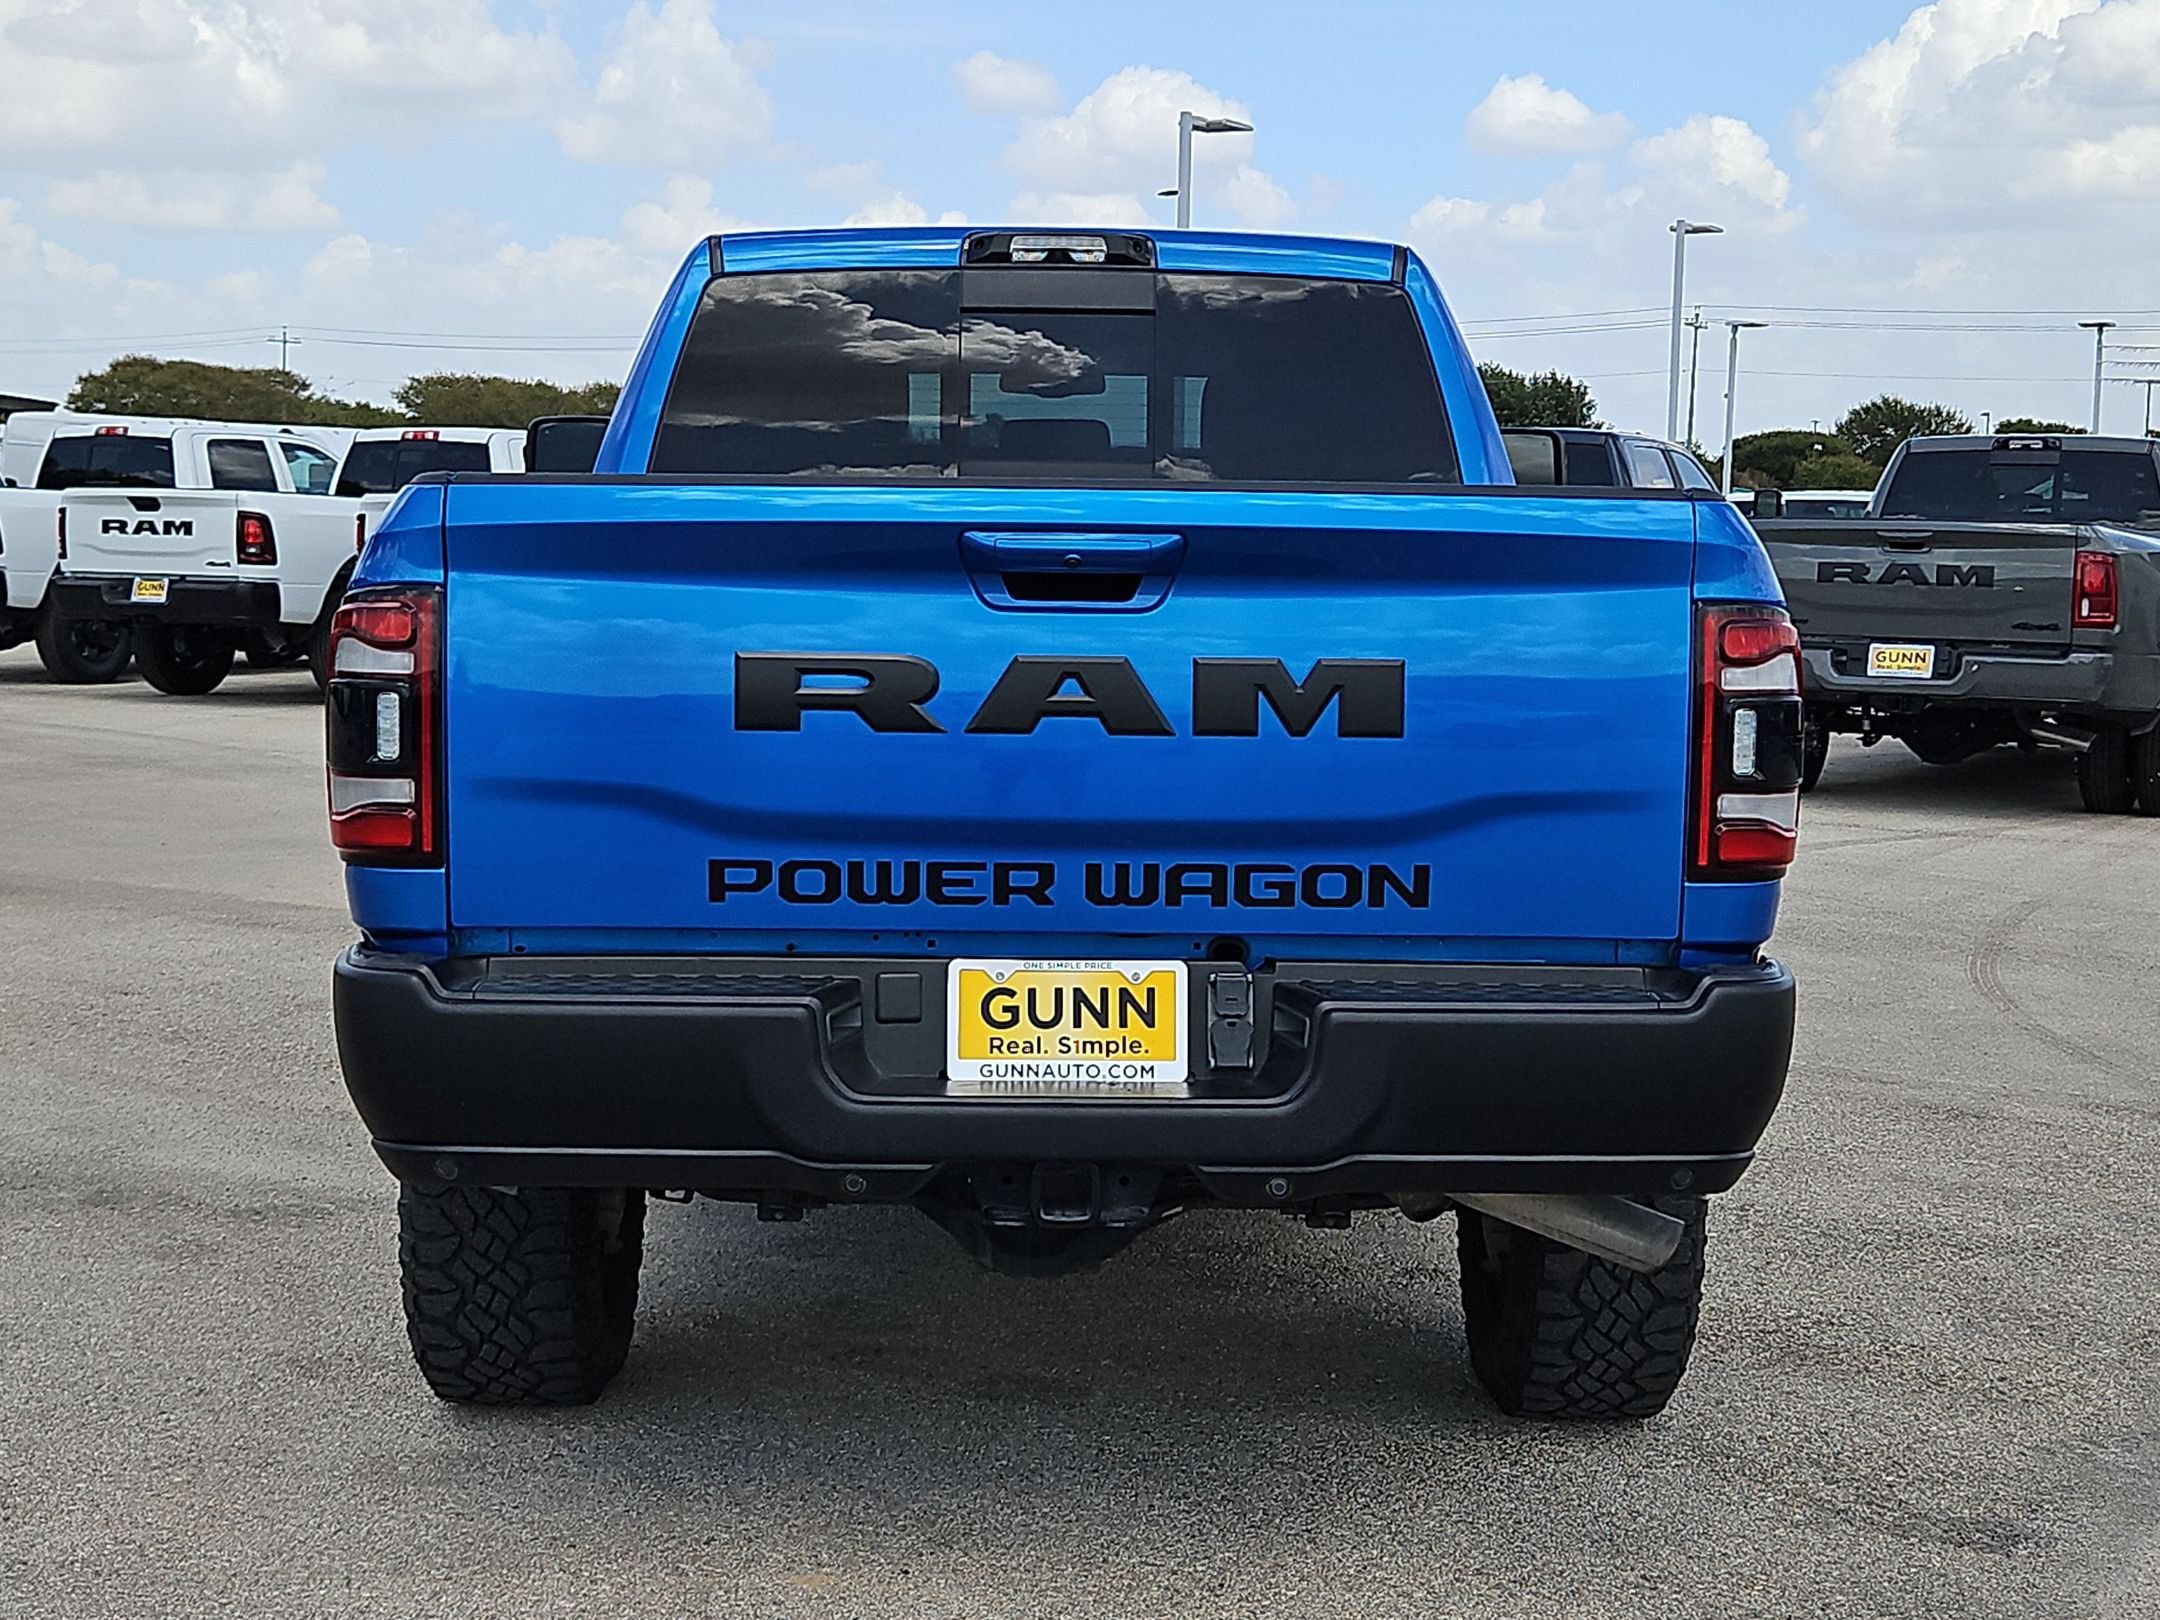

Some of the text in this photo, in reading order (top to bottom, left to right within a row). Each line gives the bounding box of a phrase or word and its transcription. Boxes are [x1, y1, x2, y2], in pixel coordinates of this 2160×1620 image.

[102, 519, 193, 536] RAM
[1816, 561, 1995, 588] RAM
[137, 582, 165, 591] GUNN
[1875, 651, 1927, 663] GUNN
[735, 651, 1406, 738] RAM
[708, 859, 1432, 908] POWER WAGON
[980, 987, 1156, 1030] GUNN
[989, 1037, 1048, 1055] Real.
[979, 1064, 1155, 1079] GUNNAUTO.COM
